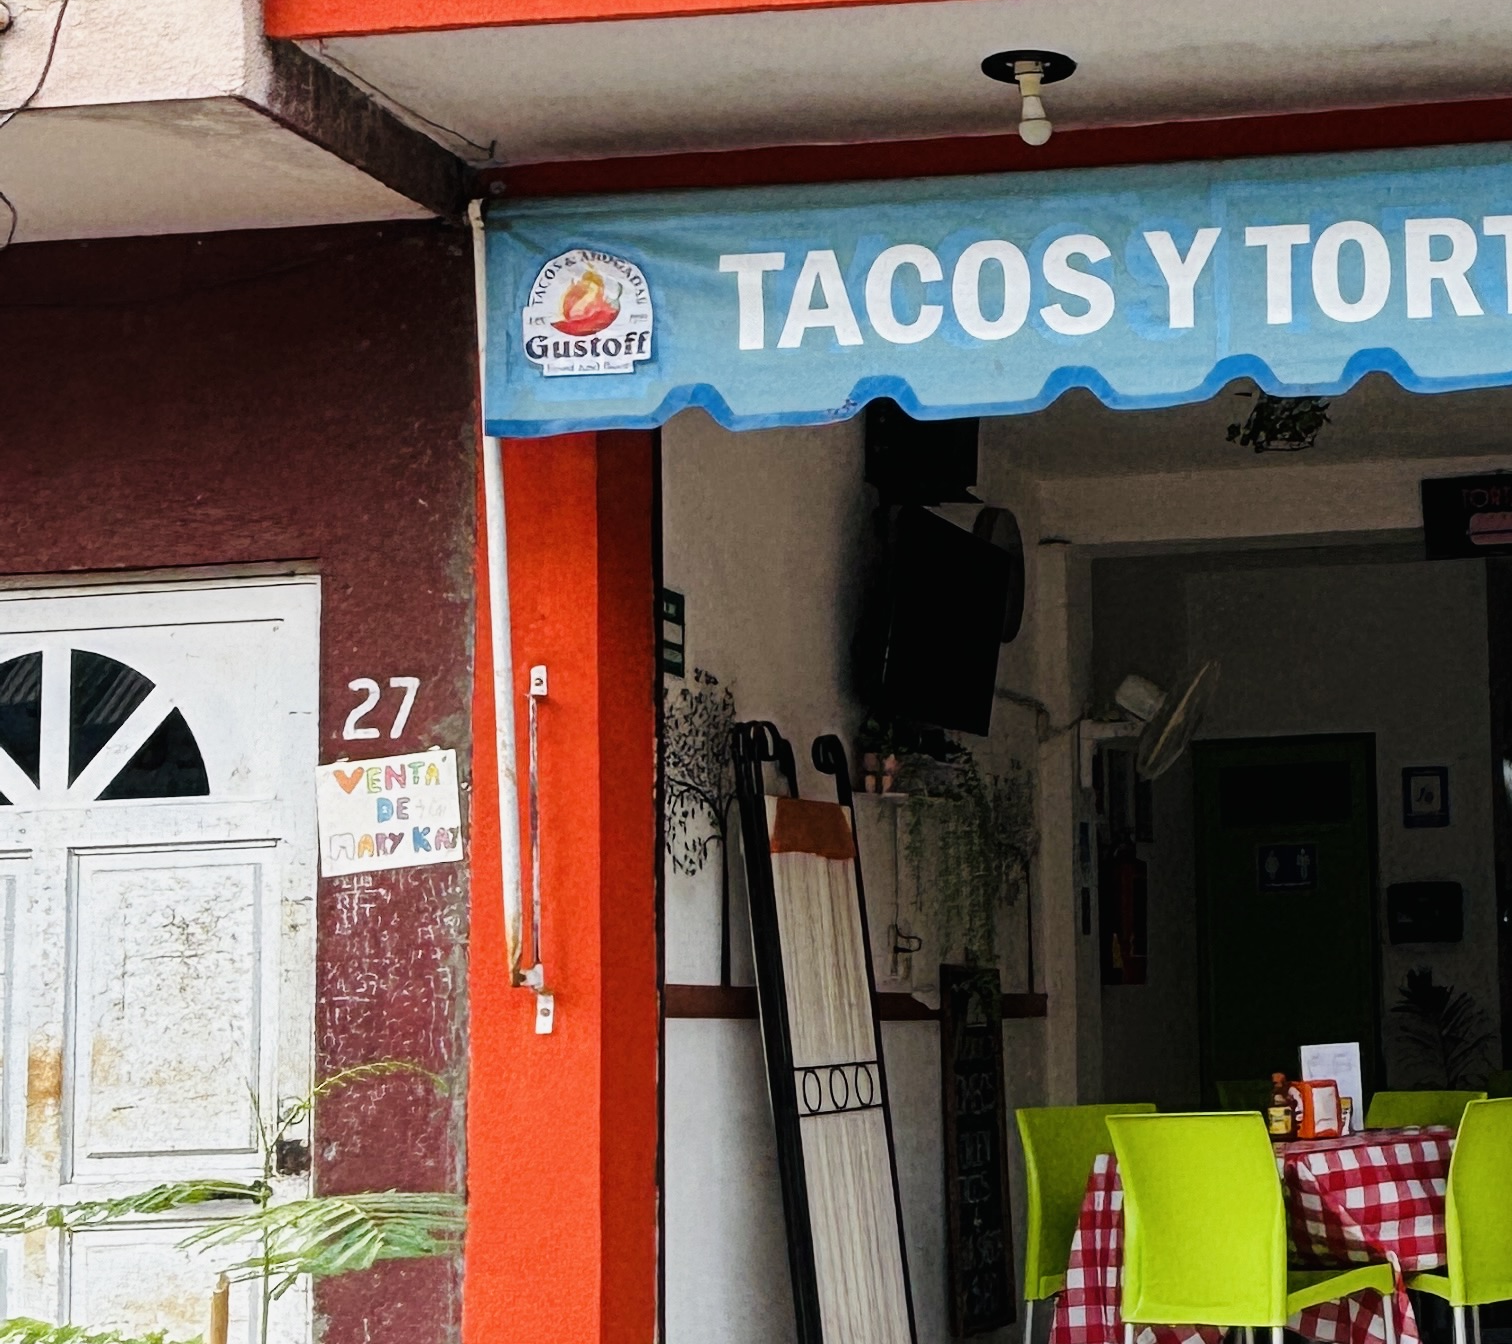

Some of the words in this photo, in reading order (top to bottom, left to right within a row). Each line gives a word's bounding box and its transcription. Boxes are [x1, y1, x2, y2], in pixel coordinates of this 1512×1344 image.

[720, 231, 1115, 351] TACOS
[1143, 228, 1222, 329] Y
[525, 331, 650, 359] Gustoff
[342, 677, 420, 740] 27
[333, 761, 440, 794] VENTA
[376, 797, 410, 823] DE
[329, 832, 404, 861] MARY
[412, 826, 459, 853] KAY
